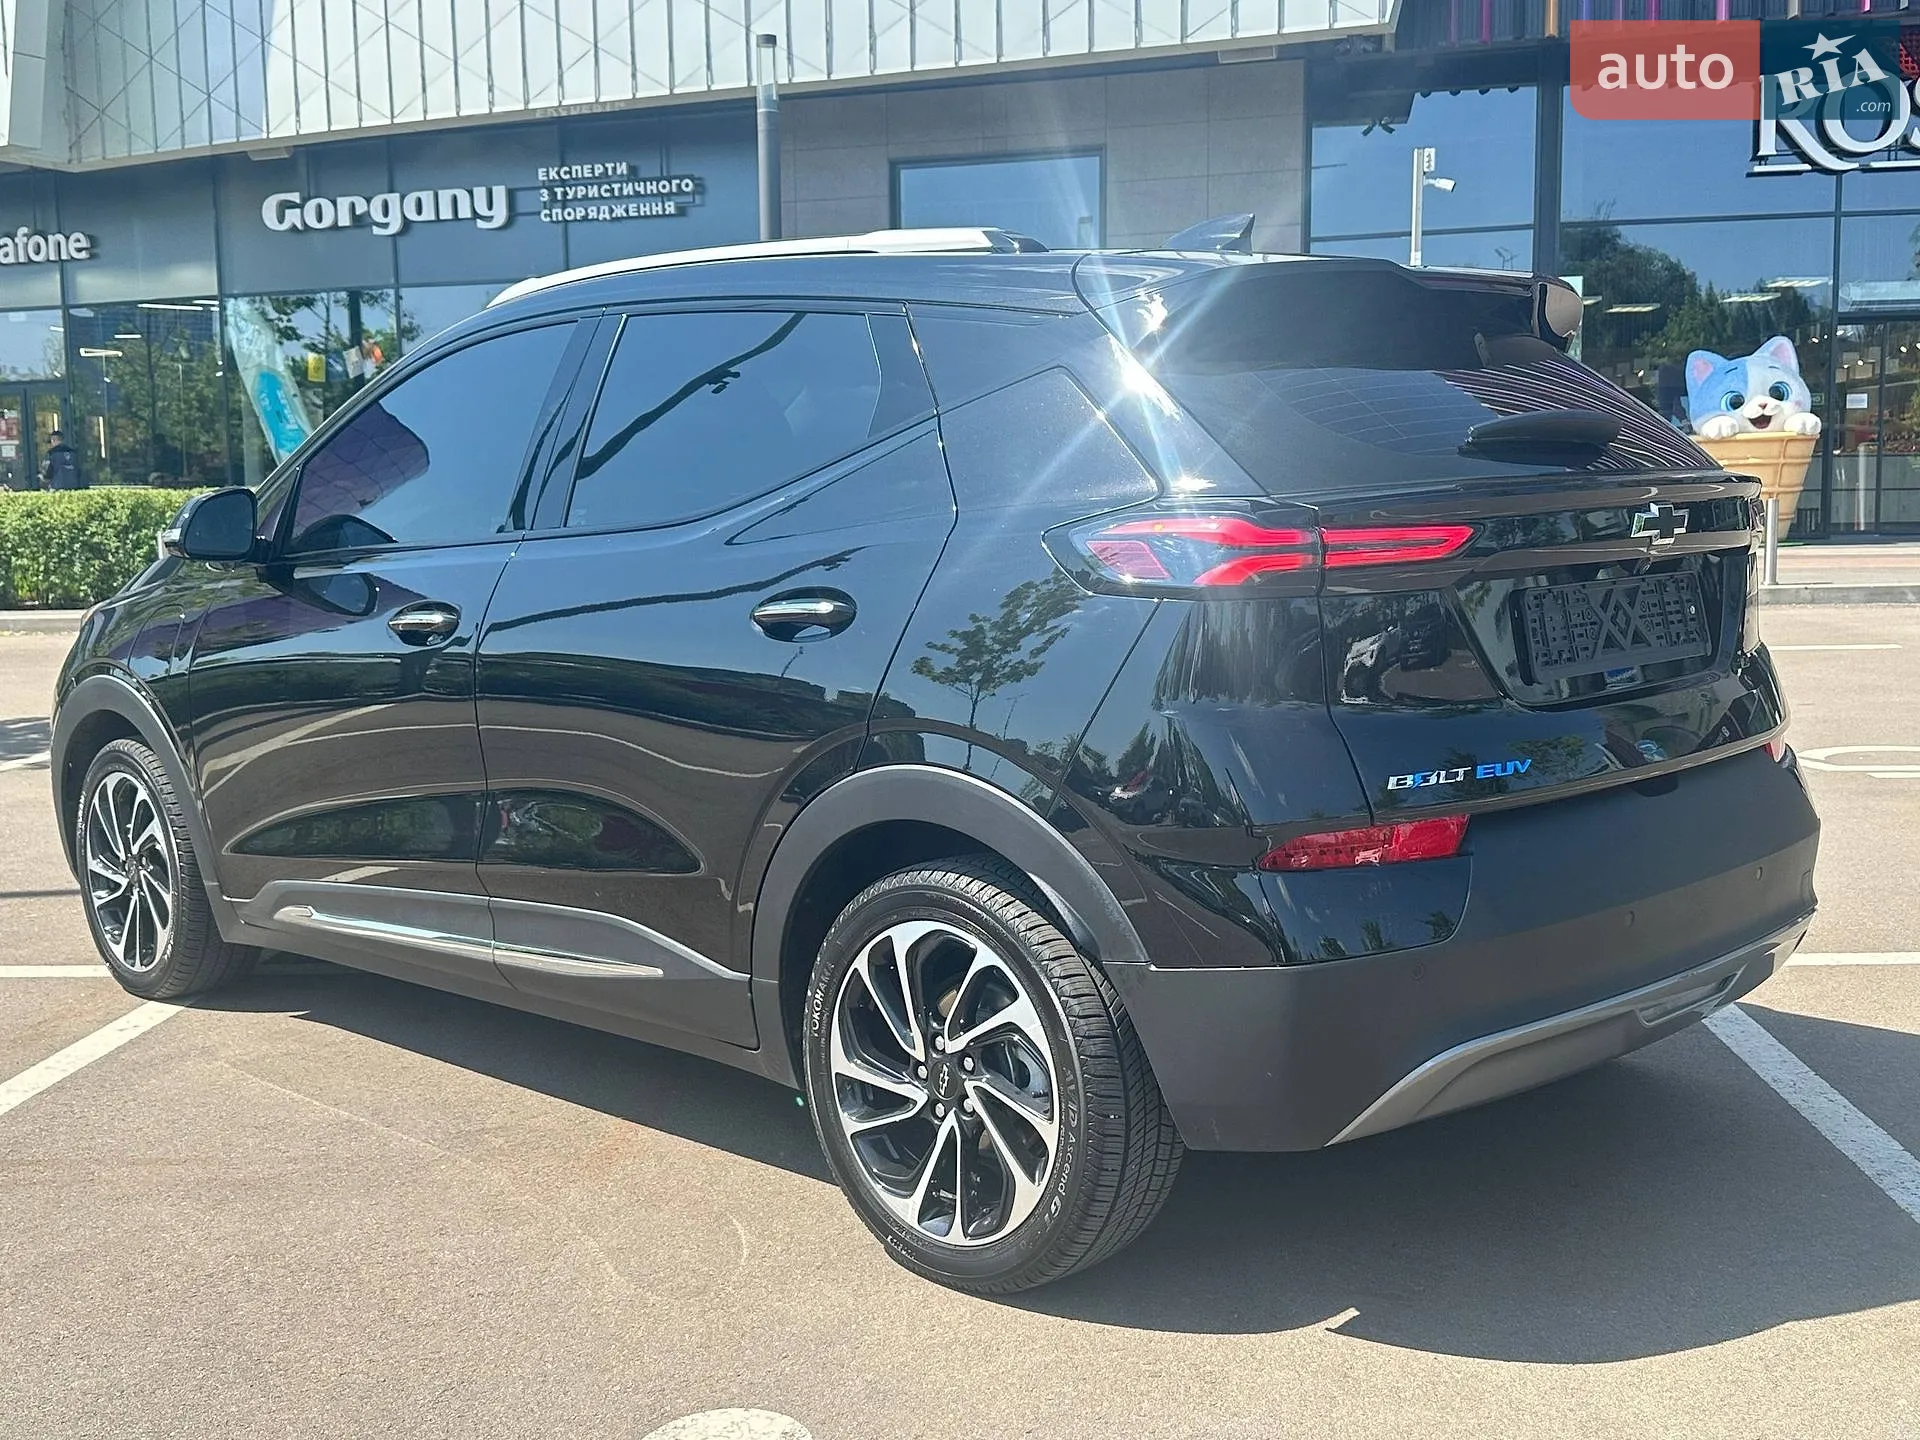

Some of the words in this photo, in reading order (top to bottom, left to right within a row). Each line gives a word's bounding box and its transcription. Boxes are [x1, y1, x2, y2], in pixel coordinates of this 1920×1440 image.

[537, 162, 628, 181] ЕКСПЕРТИ
[554, 178, 694, 201] ТУРИСТИЧНОГО
[261, 185, 509, 236] Gorgany
[540, 201, 676, 222] СПОРЯДЖЕННЯ
[0, 226, 91, 264] afone
[1387, 766, 1472, 790] BOLT
[1475, 758, 1532, 779] EUV
